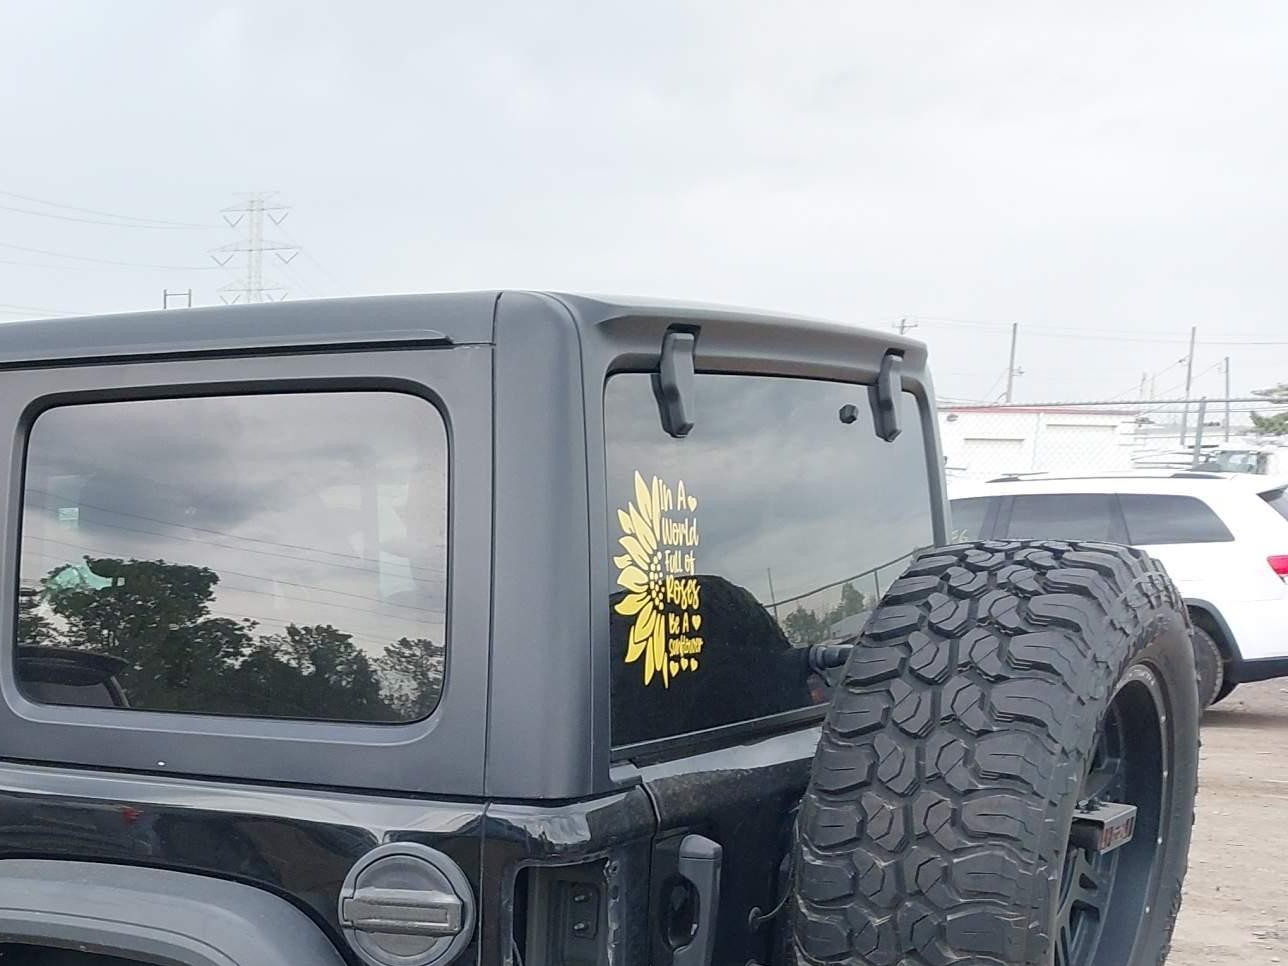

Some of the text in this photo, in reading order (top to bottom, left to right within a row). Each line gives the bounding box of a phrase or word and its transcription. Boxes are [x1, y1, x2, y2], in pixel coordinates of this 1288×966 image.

[659, 479, 687, 512] In A
[661, 517, 699, 546] World
[664, 549, 696, 575] Full of
[666, 575, 701, 610] Roses
[668, 612, 689, 634] Be A
